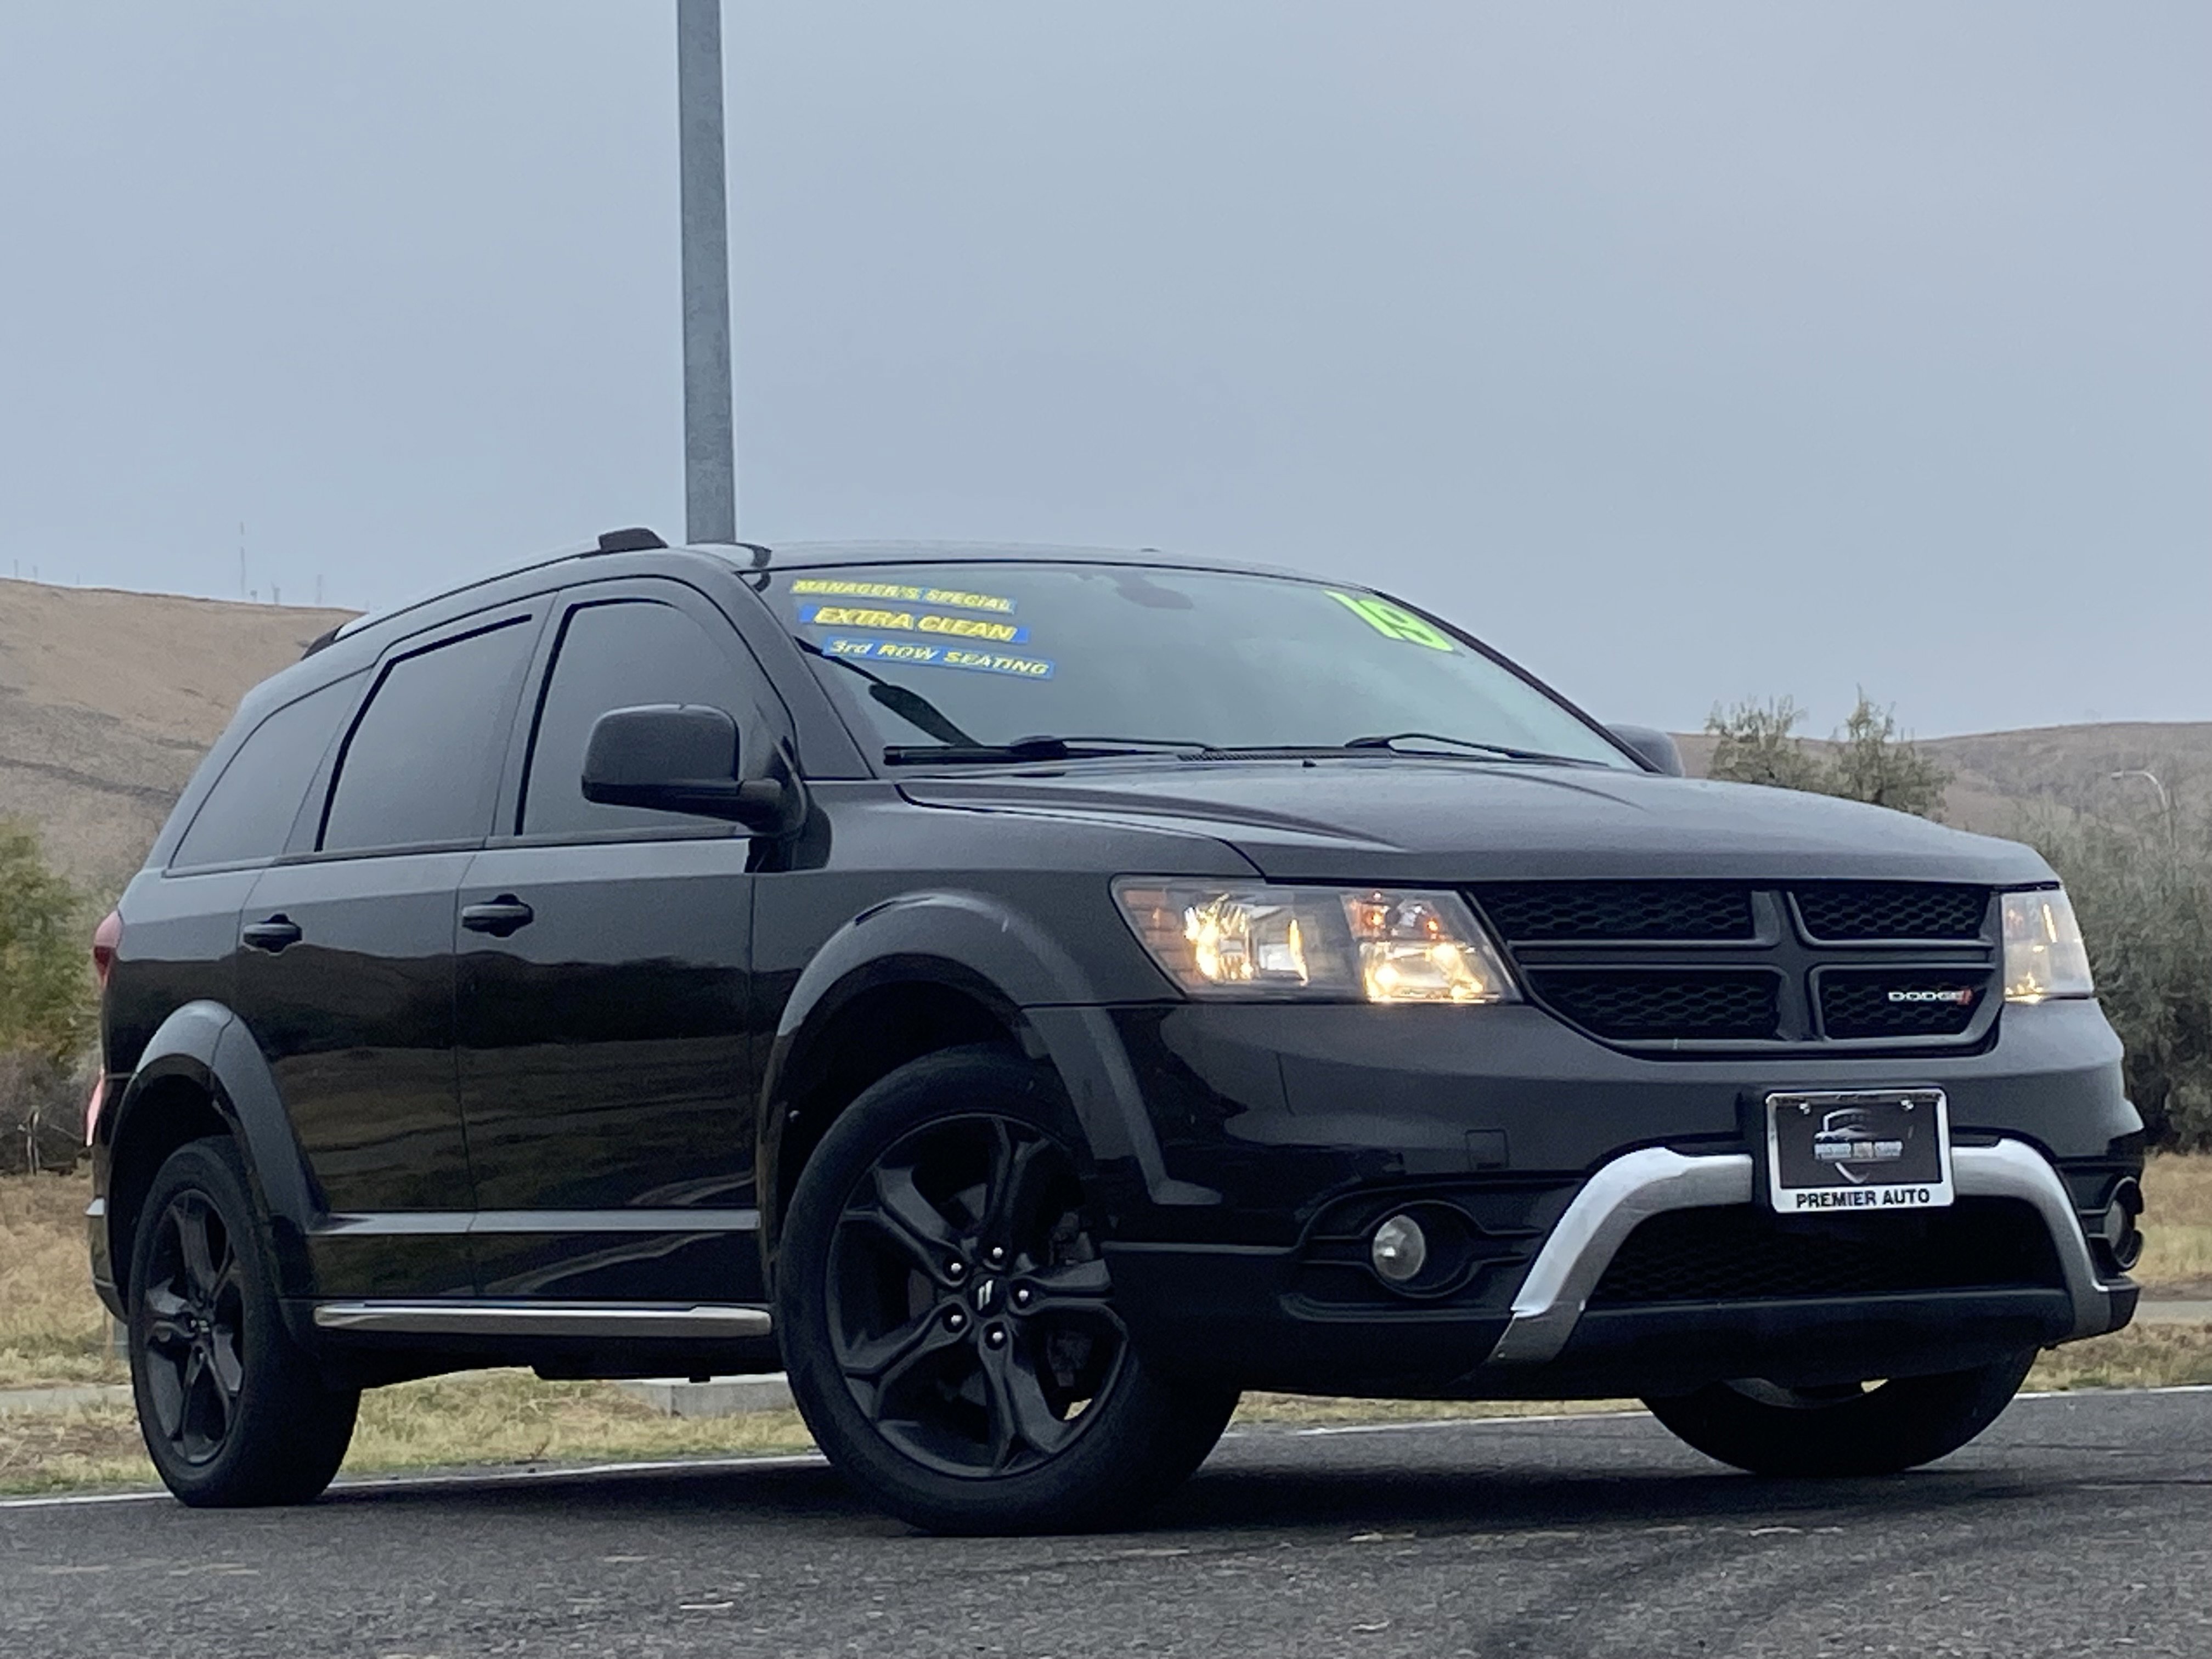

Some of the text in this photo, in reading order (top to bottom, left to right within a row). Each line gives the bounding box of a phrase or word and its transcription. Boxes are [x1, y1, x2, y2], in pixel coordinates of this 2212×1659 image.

[793, 579, 1014, 611] MANAGER'S SPECIAL
[815, 607, 1018, 641] EXTRA CLEAN
[1323, 589, 1455, 651] 19
[831, 640, 1048, 675] 3rd ROW SEATING
[1888, 991, 1964, 1002] DODGE
[1796, 1188, 1930, 1208] PREMIER AUTO
